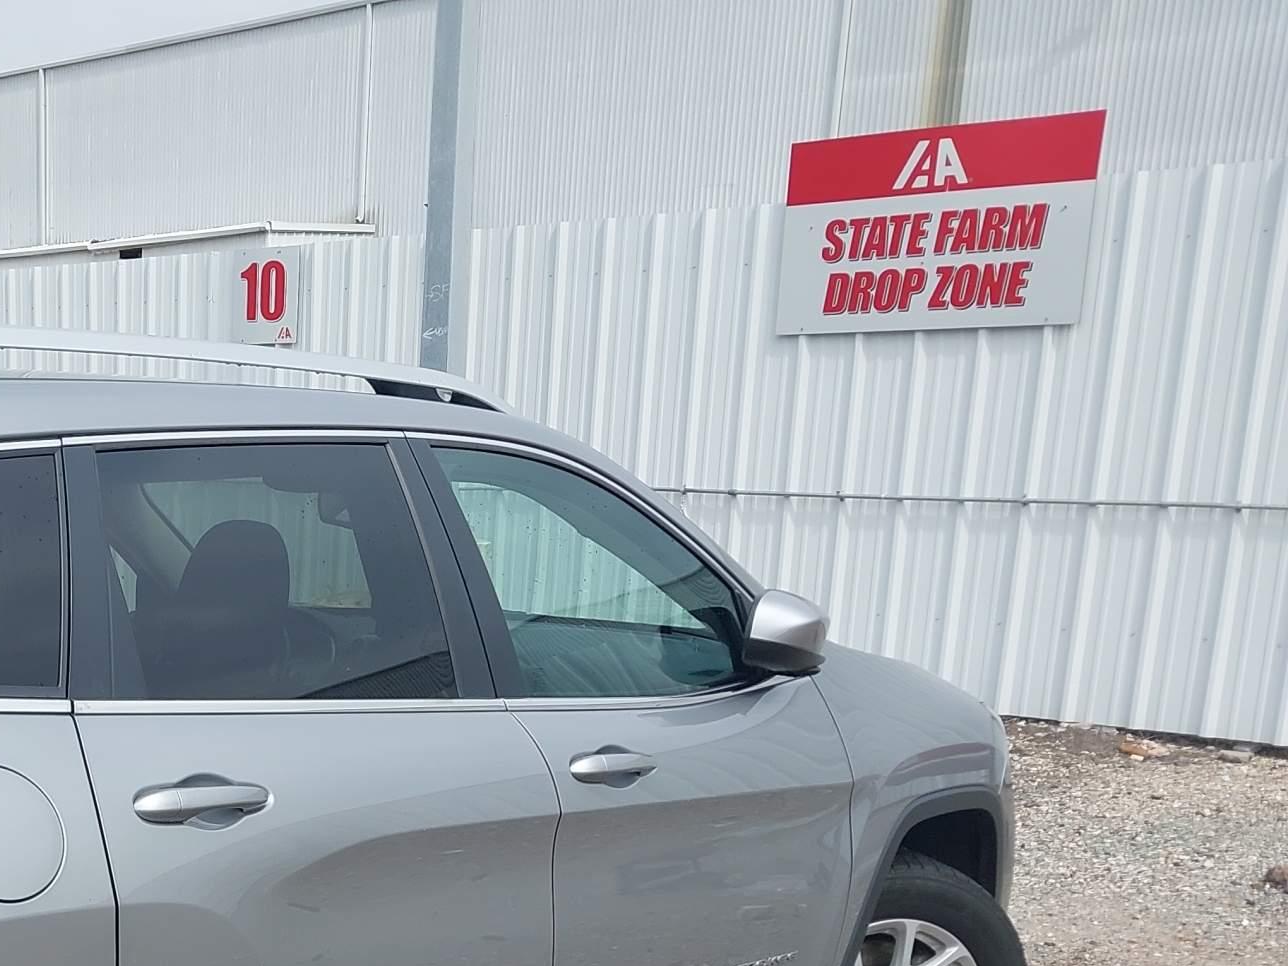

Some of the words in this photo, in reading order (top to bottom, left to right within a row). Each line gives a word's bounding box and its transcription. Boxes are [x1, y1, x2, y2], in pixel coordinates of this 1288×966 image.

[822, 212, 932, 263] STATE
[933, 202, 1050, 256] FARM
[240, 259, 287, 323] 10
[822, 266, 927, 315] DROP
[927, 261, 1033, 311] ZONE
